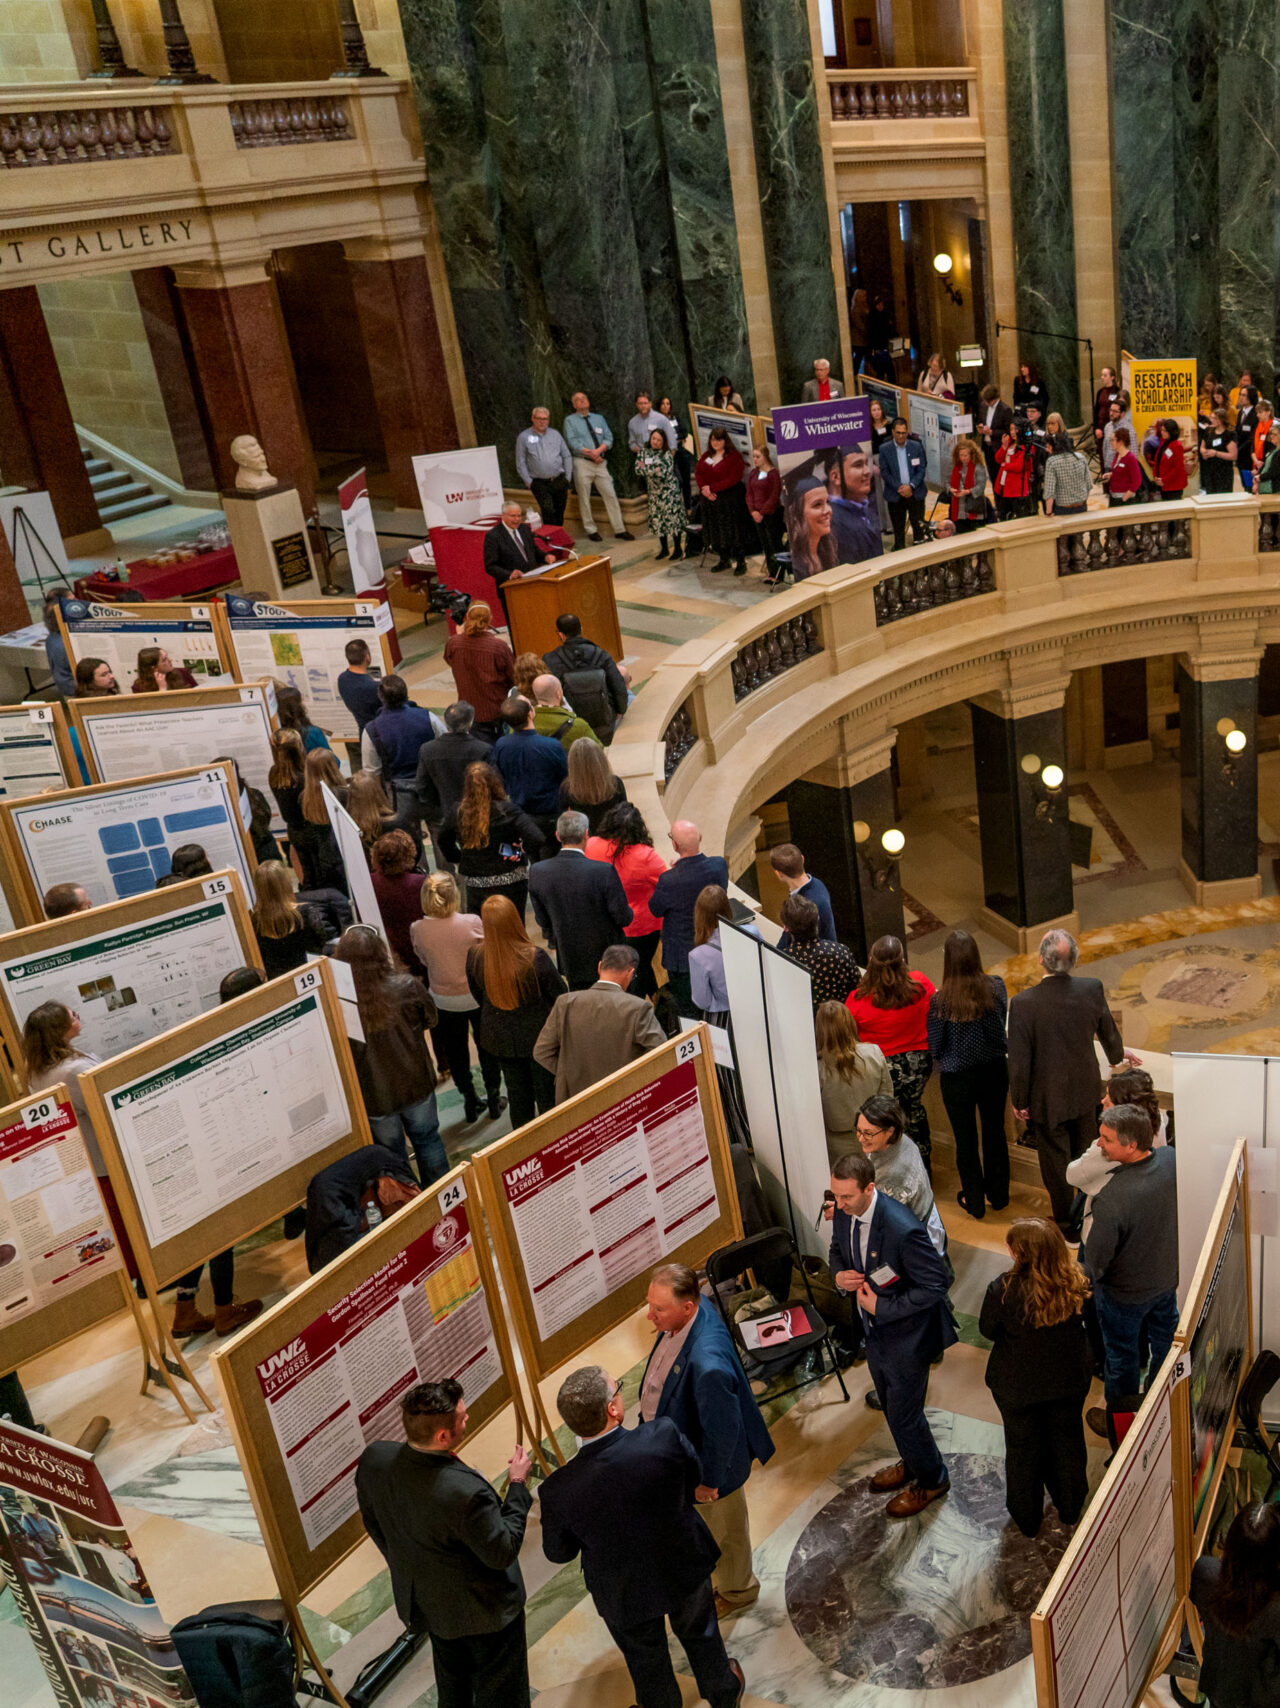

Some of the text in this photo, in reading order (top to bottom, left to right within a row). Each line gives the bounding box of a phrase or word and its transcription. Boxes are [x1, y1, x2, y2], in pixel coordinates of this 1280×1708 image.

[48, 220, 192, 258] GALLERY
[1134, 372, 1192, 389] RESEARCH
[1135, 389, 1193, 404] SCHOLARSHIP
[804, 415, 830, 424] University
[838, 410, 863, 419] Wisconsin
[1142, 405, 1167, 413] CREATIVE
[1168, 404, 1192, 412] ACTIVITY
[805, 419, 864, 436] Whitewater
[92, 605, 123, 617] STOUT
[257, 604, 286, 616] STOUT
[362, 606, 367, 614] 3
[247, 691, 254, 699] 7
[38, 710, 45, 719] 8
[206, 771, 221, 783] 11
[208, 881, 226, 894] 15
[26, 954, 72, 974] GREEN BAY
[300, 974, 315, 989] 19
[680, 1041, 695, 1058] 23
[132, 1074, 176, 1100] GREEN BAY
[29, 1104, 50, 1122] 20
[509, 1171, 544, 1197] LA CROSSE
[443, 1186, 460, 1208] 24
[327, 1293, 349, 1317] Security
[349, 1274, 374, 1299] Selection
[373, 1261, 390, 1280] Model
[389, 1255, 397, 1267] for
[397, 1248, 406, 1260] the
[331, 1302, 350, 1324] Gordon
[350, 1283, 374, 1308] Spellman
[374, 1273, 388, 1288] Fund
[387, 1261, 403, 1278] Phase
[265, 1353, 310, 1392] LA CROSSE
[0, 1443, 90, 1488] A CROSSE
[40, 1450, 84, 1474] WISCONSIN
